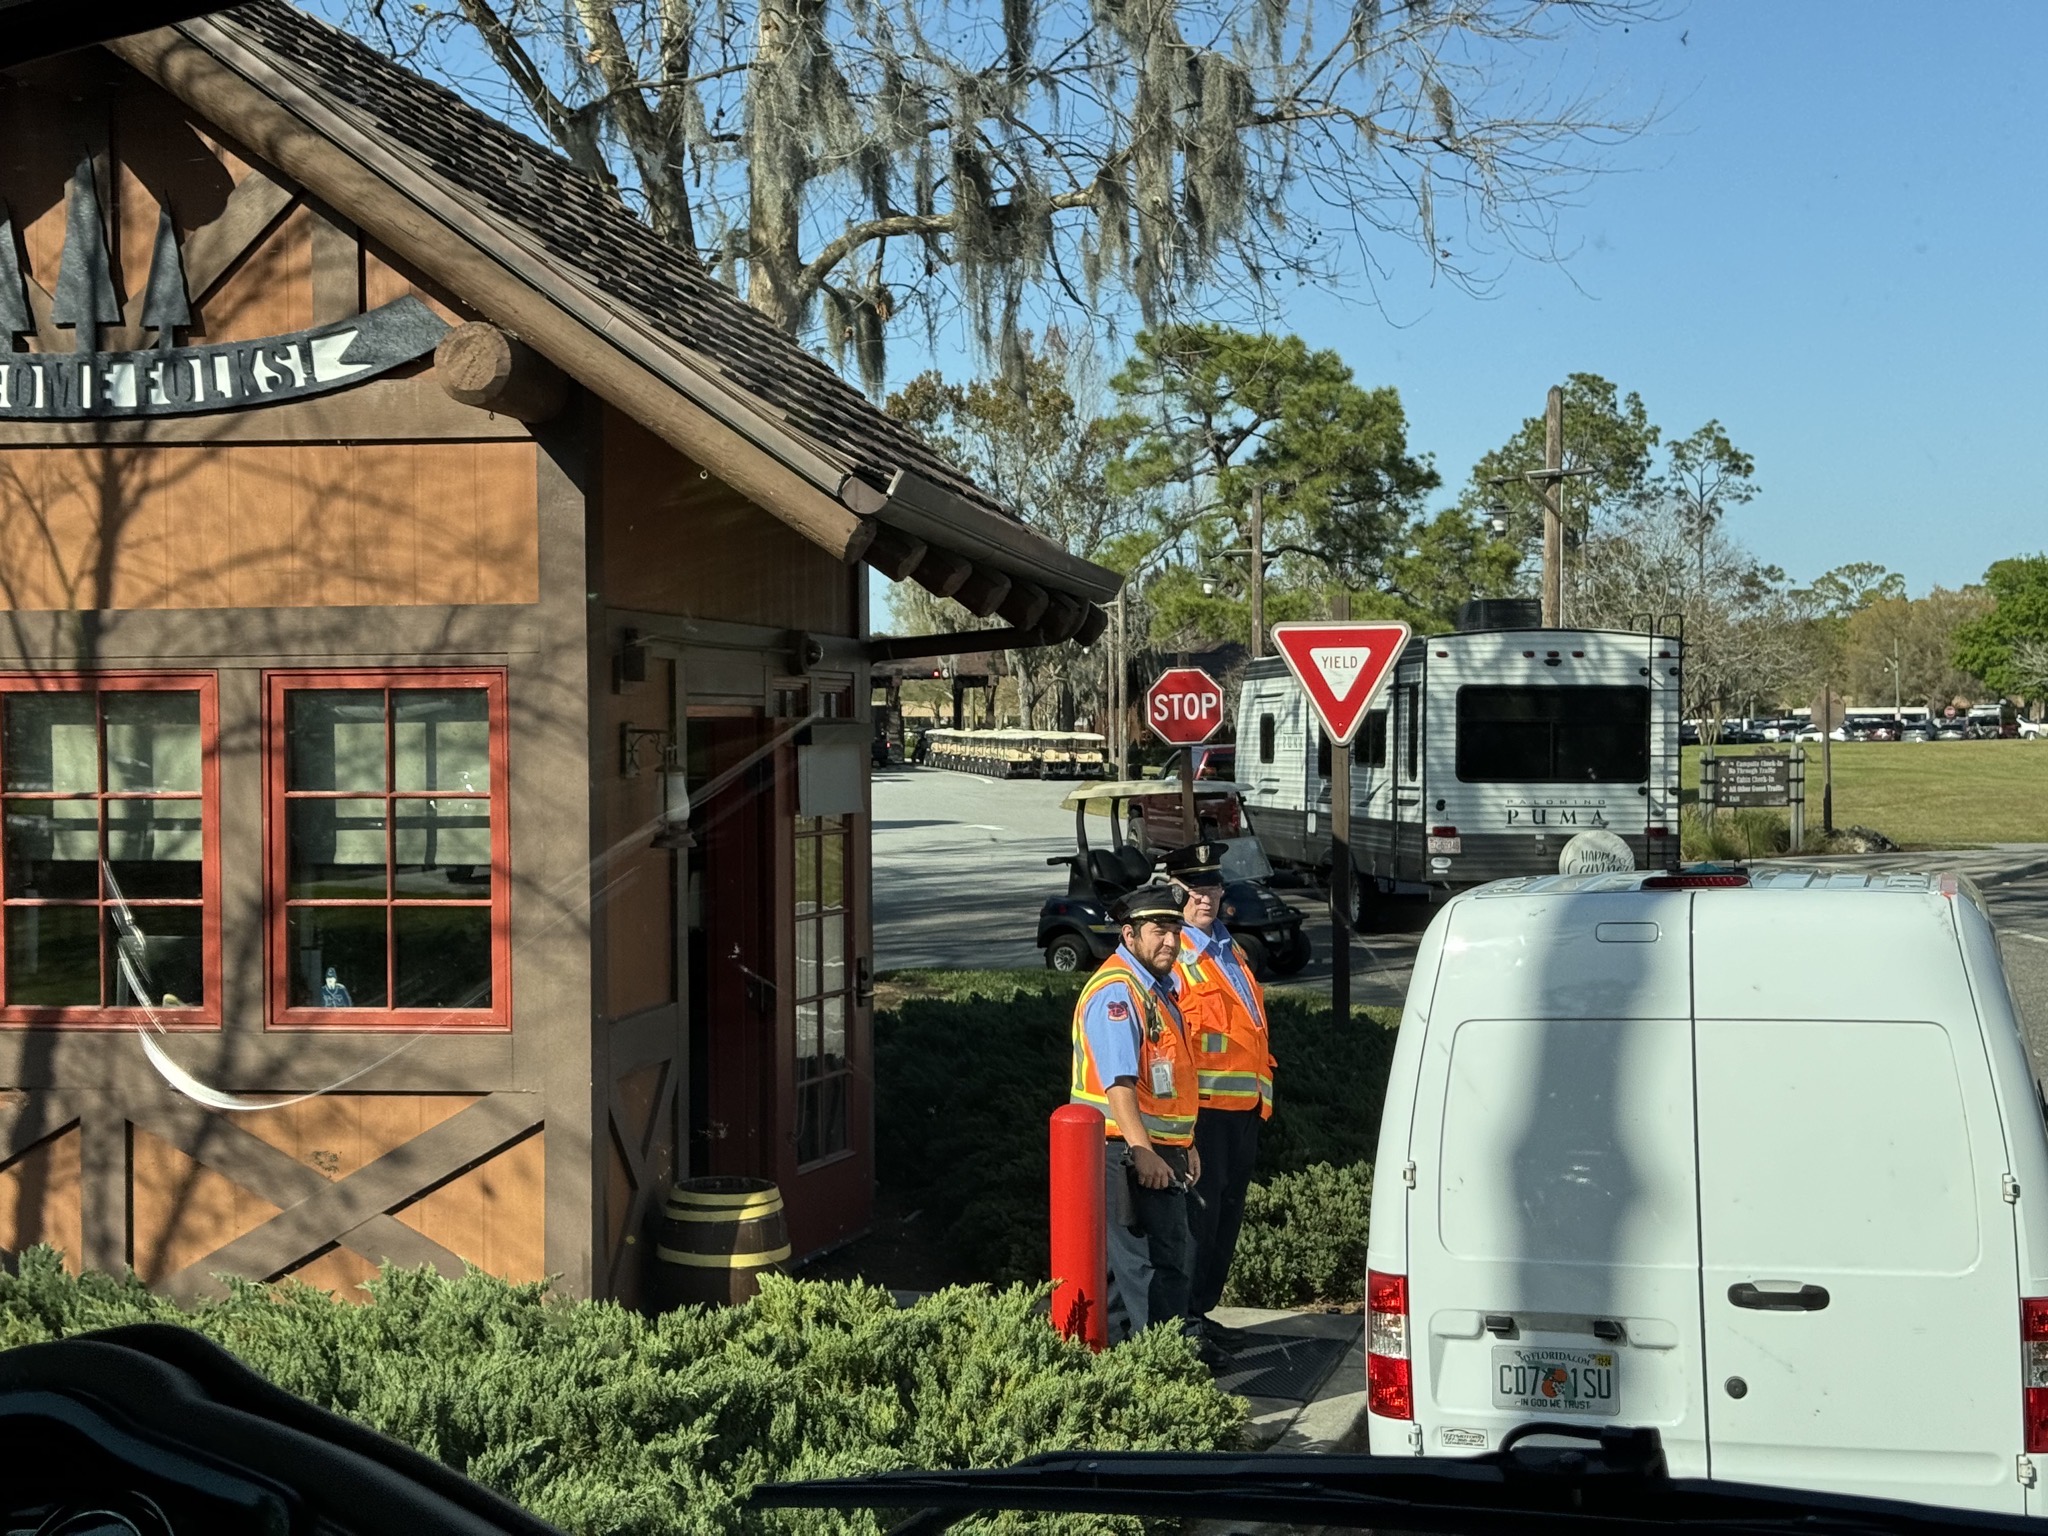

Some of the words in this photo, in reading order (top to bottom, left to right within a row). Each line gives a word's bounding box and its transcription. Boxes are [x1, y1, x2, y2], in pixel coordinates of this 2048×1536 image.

[0, 361, 113, 408] OME
[139, 342, 313, 404] FOLKS!
[1321, 655, 1358, 669] YIELD
[1154, 692, 1217, 721] STOP
[1506, 809, 1606, 825] PUMA
[1521, 1398, 1529, 1406] IN
[1531, 1399, 1548, 1408] GOD
[1550, 1399, 1561, 1408] WE
[1563, 1400, 1590, 1409] TRUST
